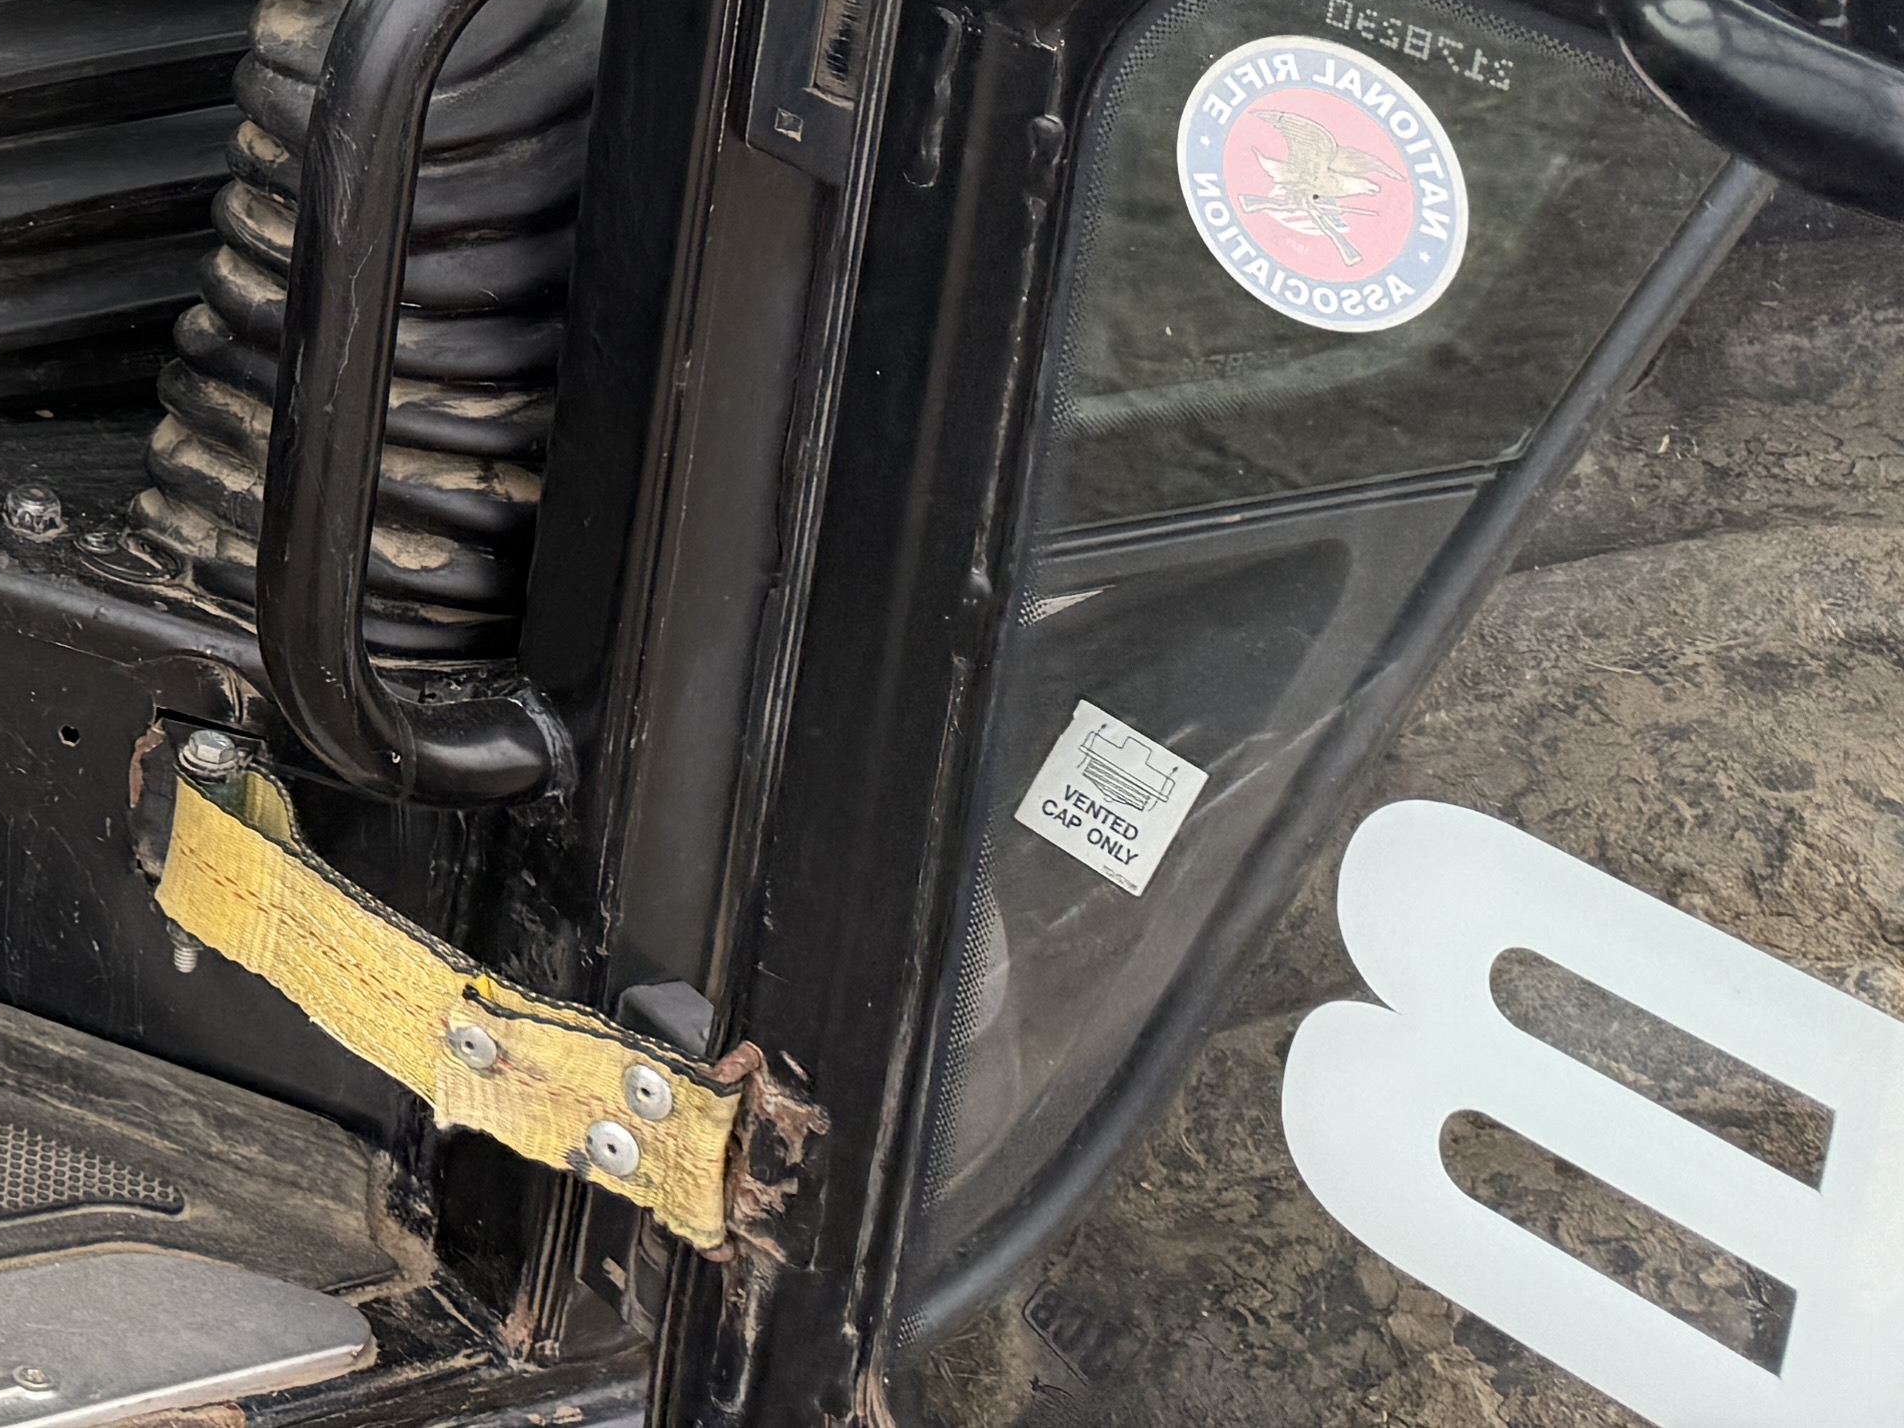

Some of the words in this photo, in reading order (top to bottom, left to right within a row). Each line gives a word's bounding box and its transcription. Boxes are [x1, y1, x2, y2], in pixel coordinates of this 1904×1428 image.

[1041, 798, 1082, 830] CAP
[1086, 826, 1140, 866] ONLY
[1064, 784, 1139, 840] VENTED
